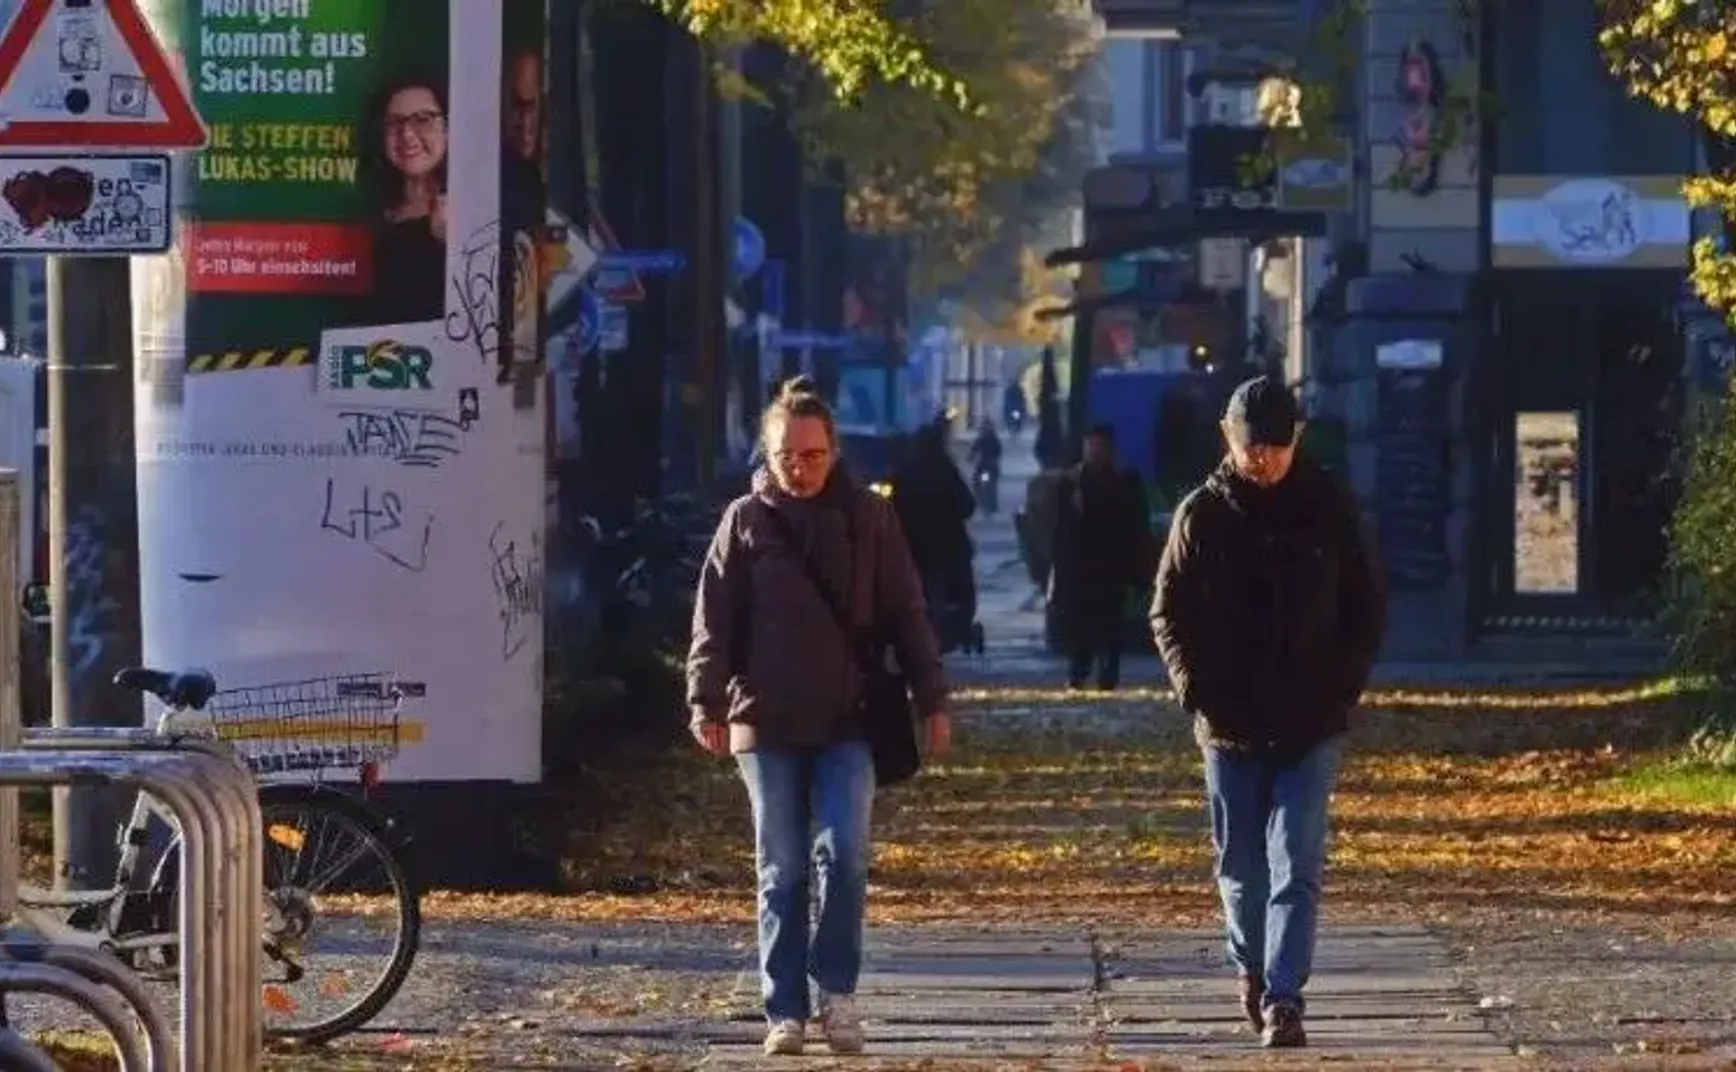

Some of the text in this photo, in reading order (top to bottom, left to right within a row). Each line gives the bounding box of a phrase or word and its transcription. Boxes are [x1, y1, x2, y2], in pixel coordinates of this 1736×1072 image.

[202, 0, 309, 25] Morgen
[200, 25, 367, 58] kommt aus
[200, 60, 336, 94] Sachsen!
[208, 124, 351, 150] IE STEFFEN
[199, 155, 358, 183] LUKAS-SHOW
[341, 339, 434, 389] PSR
